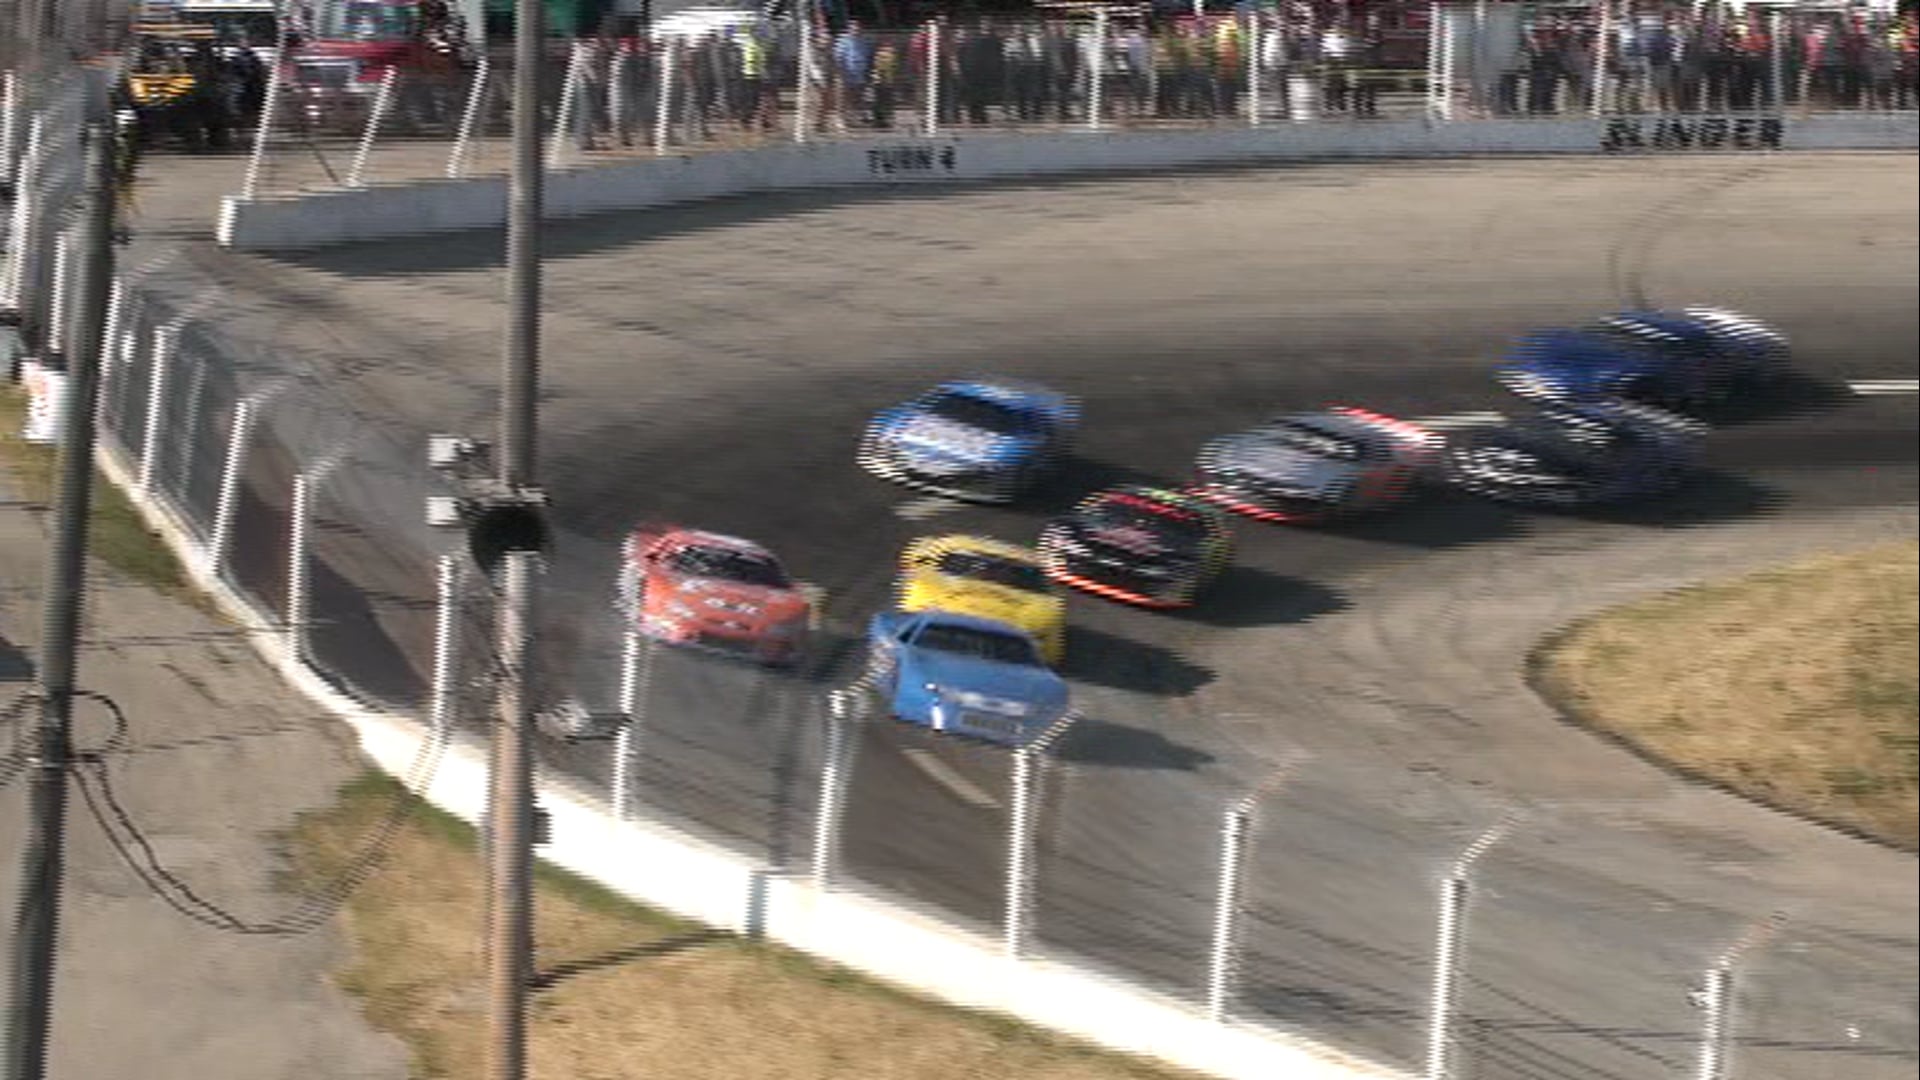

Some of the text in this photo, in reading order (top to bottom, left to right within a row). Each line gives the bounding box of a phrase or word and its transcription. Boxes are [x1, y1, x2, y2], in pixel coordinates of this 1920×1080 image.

[1602, 118, 1784, 151] SLINGER
[866, 144, 957, 175] TURN 4
